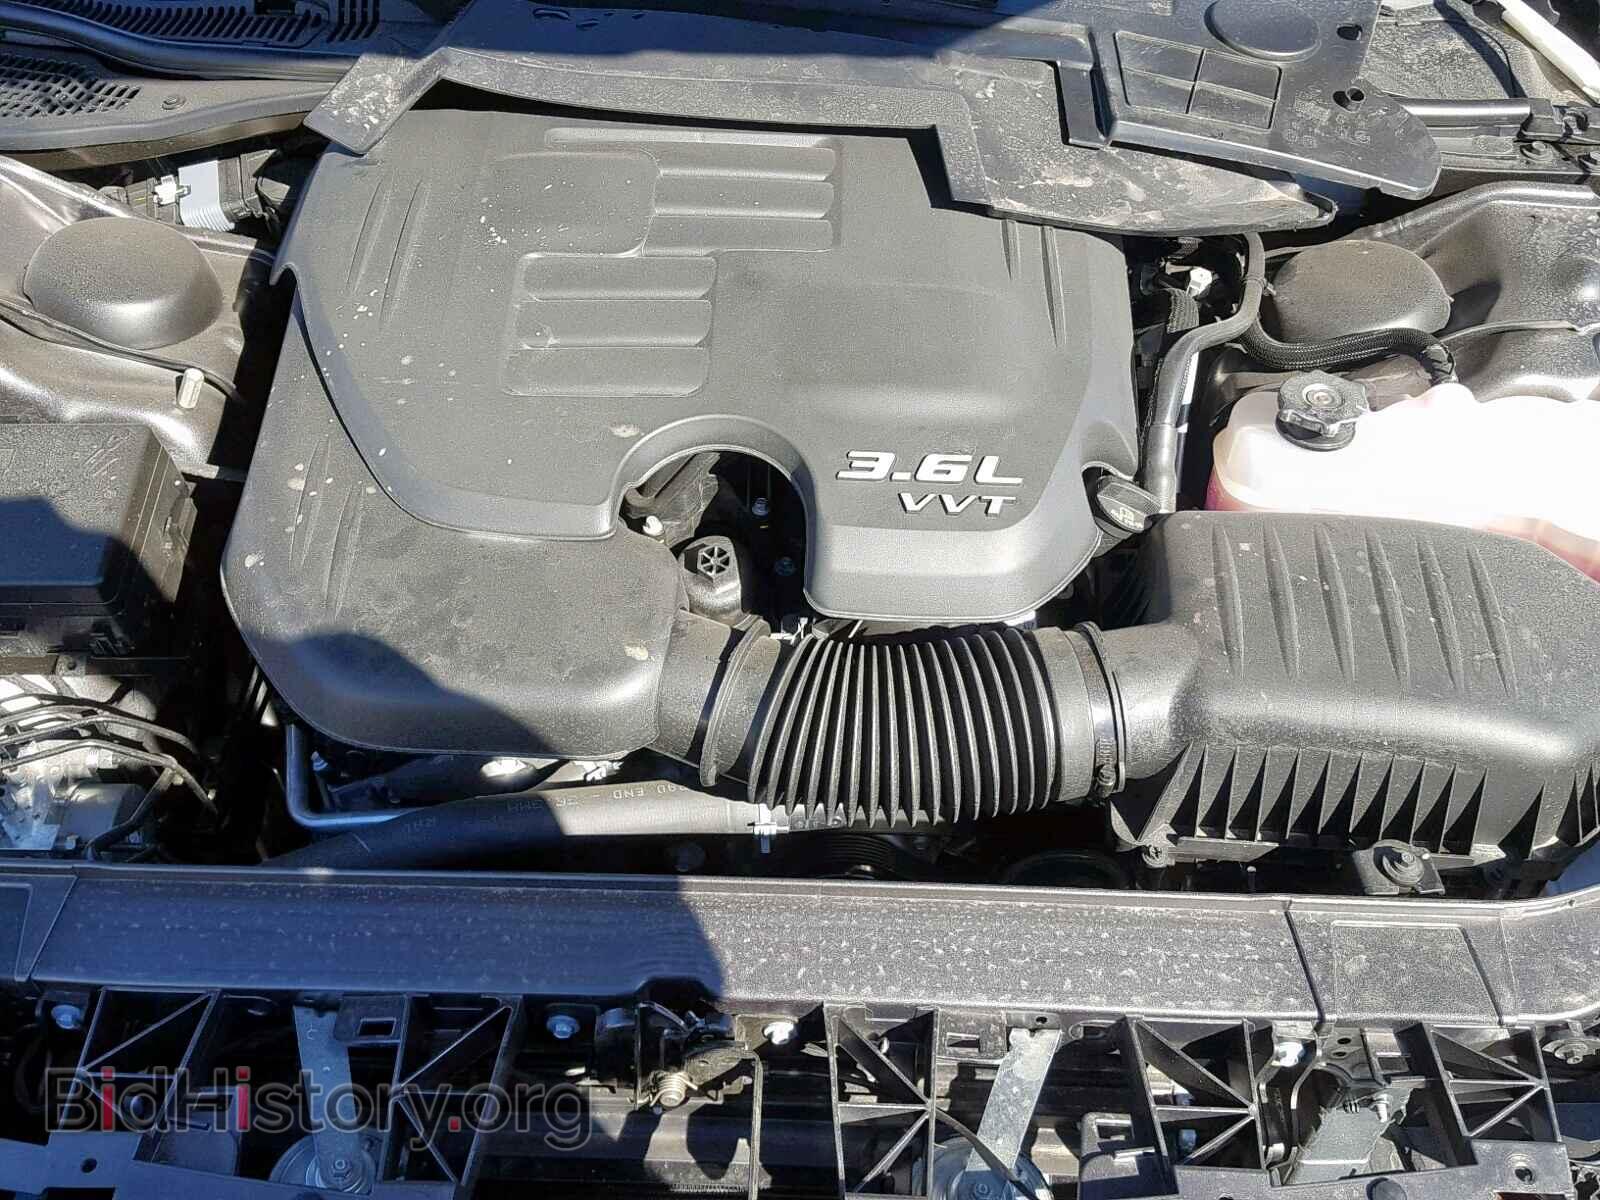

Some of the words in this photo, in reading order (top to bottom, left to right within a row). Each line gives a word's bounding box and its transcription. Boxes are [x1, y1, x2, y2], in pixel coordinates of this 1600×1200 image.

[836, 450, 1024, 486] 3.6L
[898, 492, 1016, 517] VVT
[612, 786, 645, 799] END
